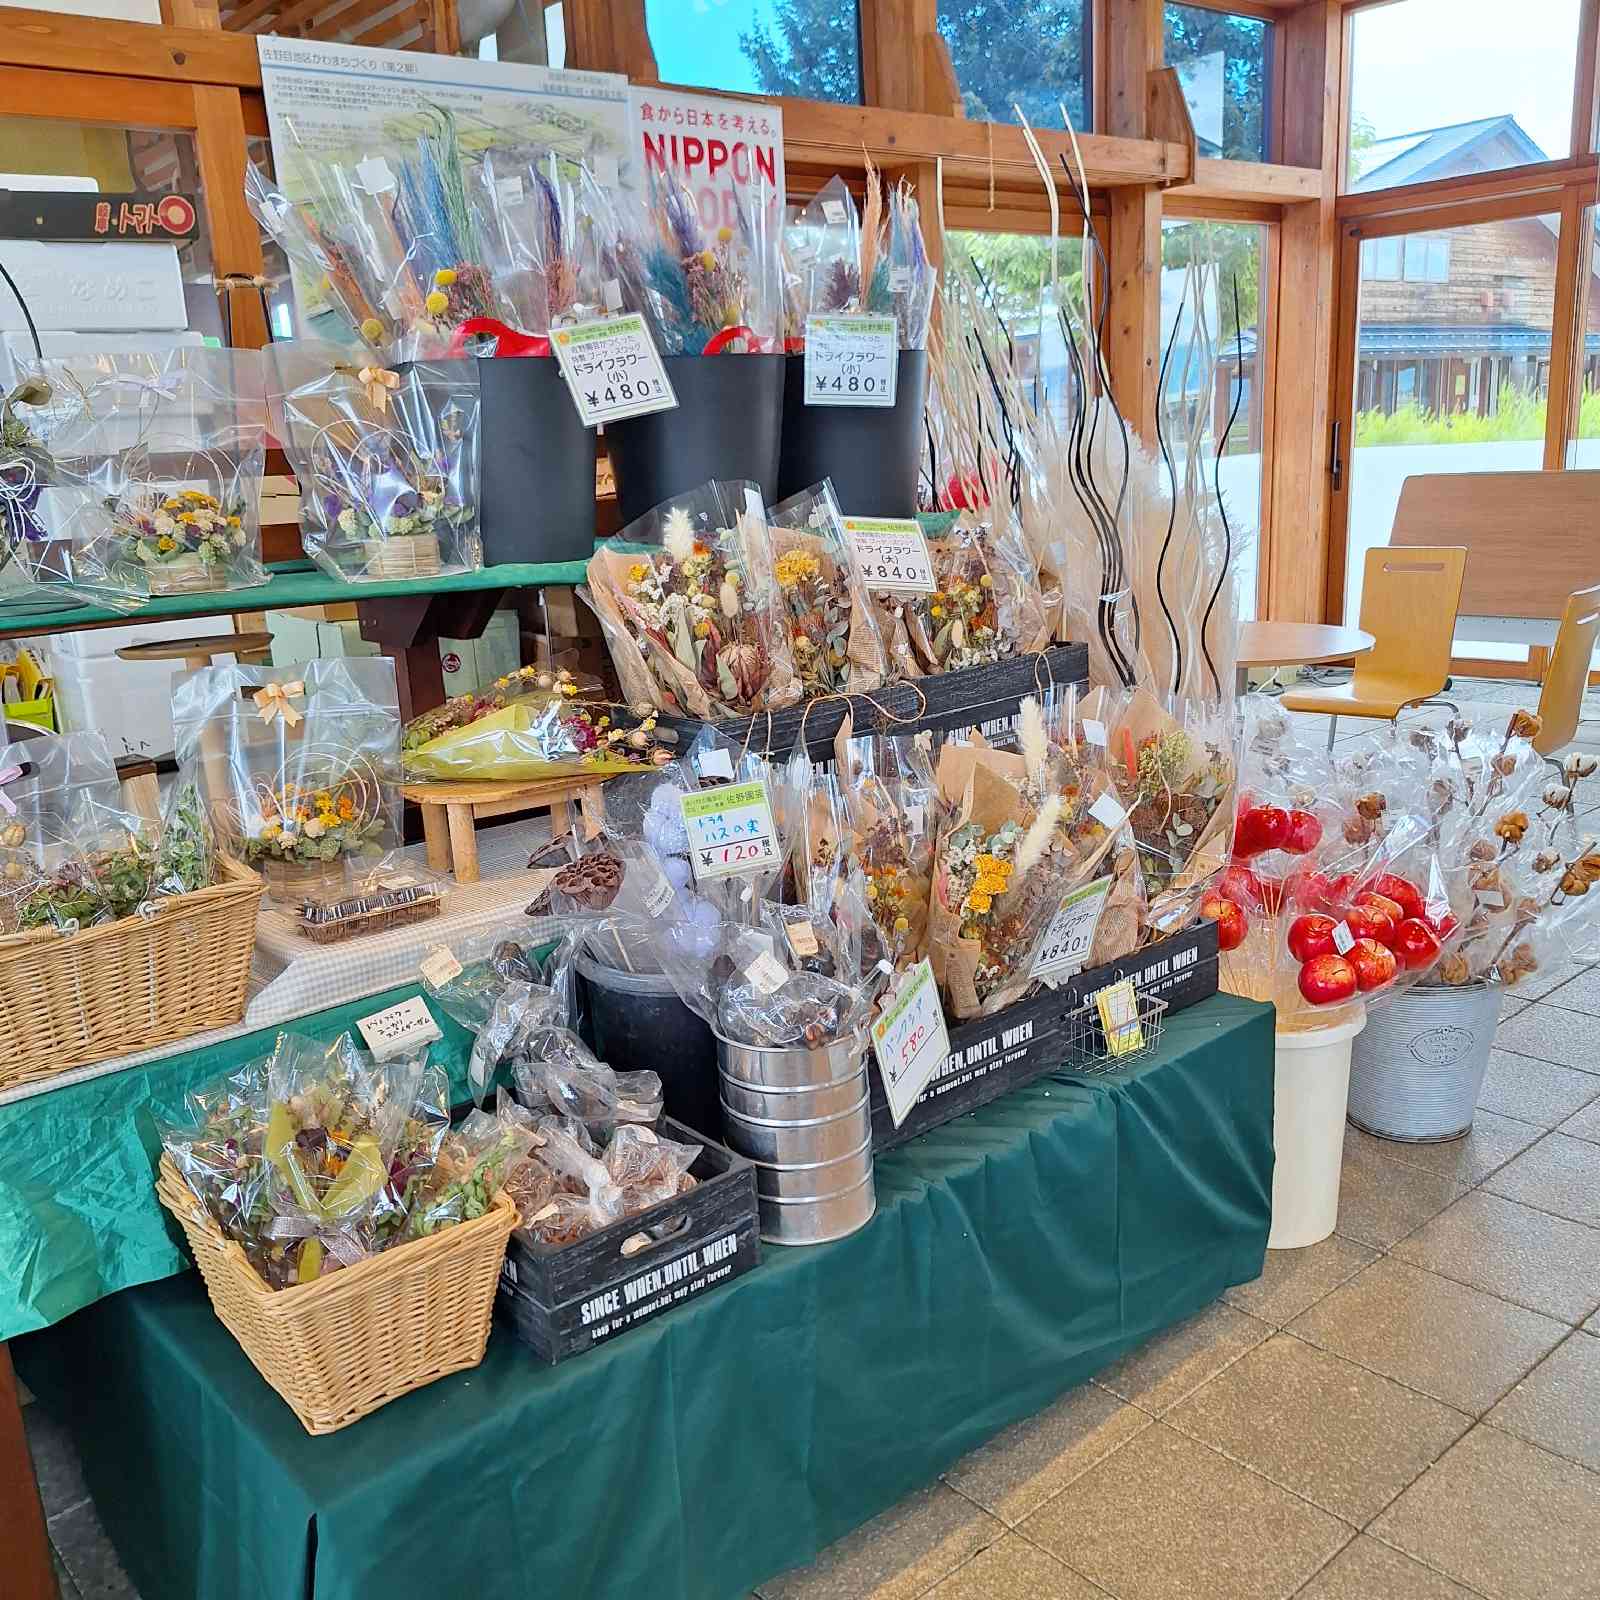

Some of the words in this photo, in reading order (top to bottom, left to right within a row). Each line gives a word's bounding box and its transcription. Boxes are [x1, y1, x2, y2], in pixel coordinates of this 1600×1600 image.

[641, 101, 777, 138] 食から日本を考える。
[643, 131, 776, 188] NIPPON
[573, 354, 649, 377] ドライフラワー
[815, 351, 887, 363] ドライフラワー
[584, 380, 650, 407] ¥480
[816, 376, 875, 393] ¥480
[857, 545, 921, 555] ドライフラワー
[861, 564, 917, 580] ¥840
[705, 818, 759, 842] ハスの実
[1040, 937, 1081, 961] ¥840
[1173, 946, 1198, 971] WHEN
[1001, 1020, 1033, 1050] WHEN
[1004, 1048, 1028, 1064] forever
[581, 1288, 621, 1326] SINCE
[702, 1233, 738, 1267] WHEN
[611, 1317, 624, 1330] for
[674, 1286, 689, 1299] may
[690, 1278, 705, 1292] stay
[706, 1264, 732, 1284] forever
